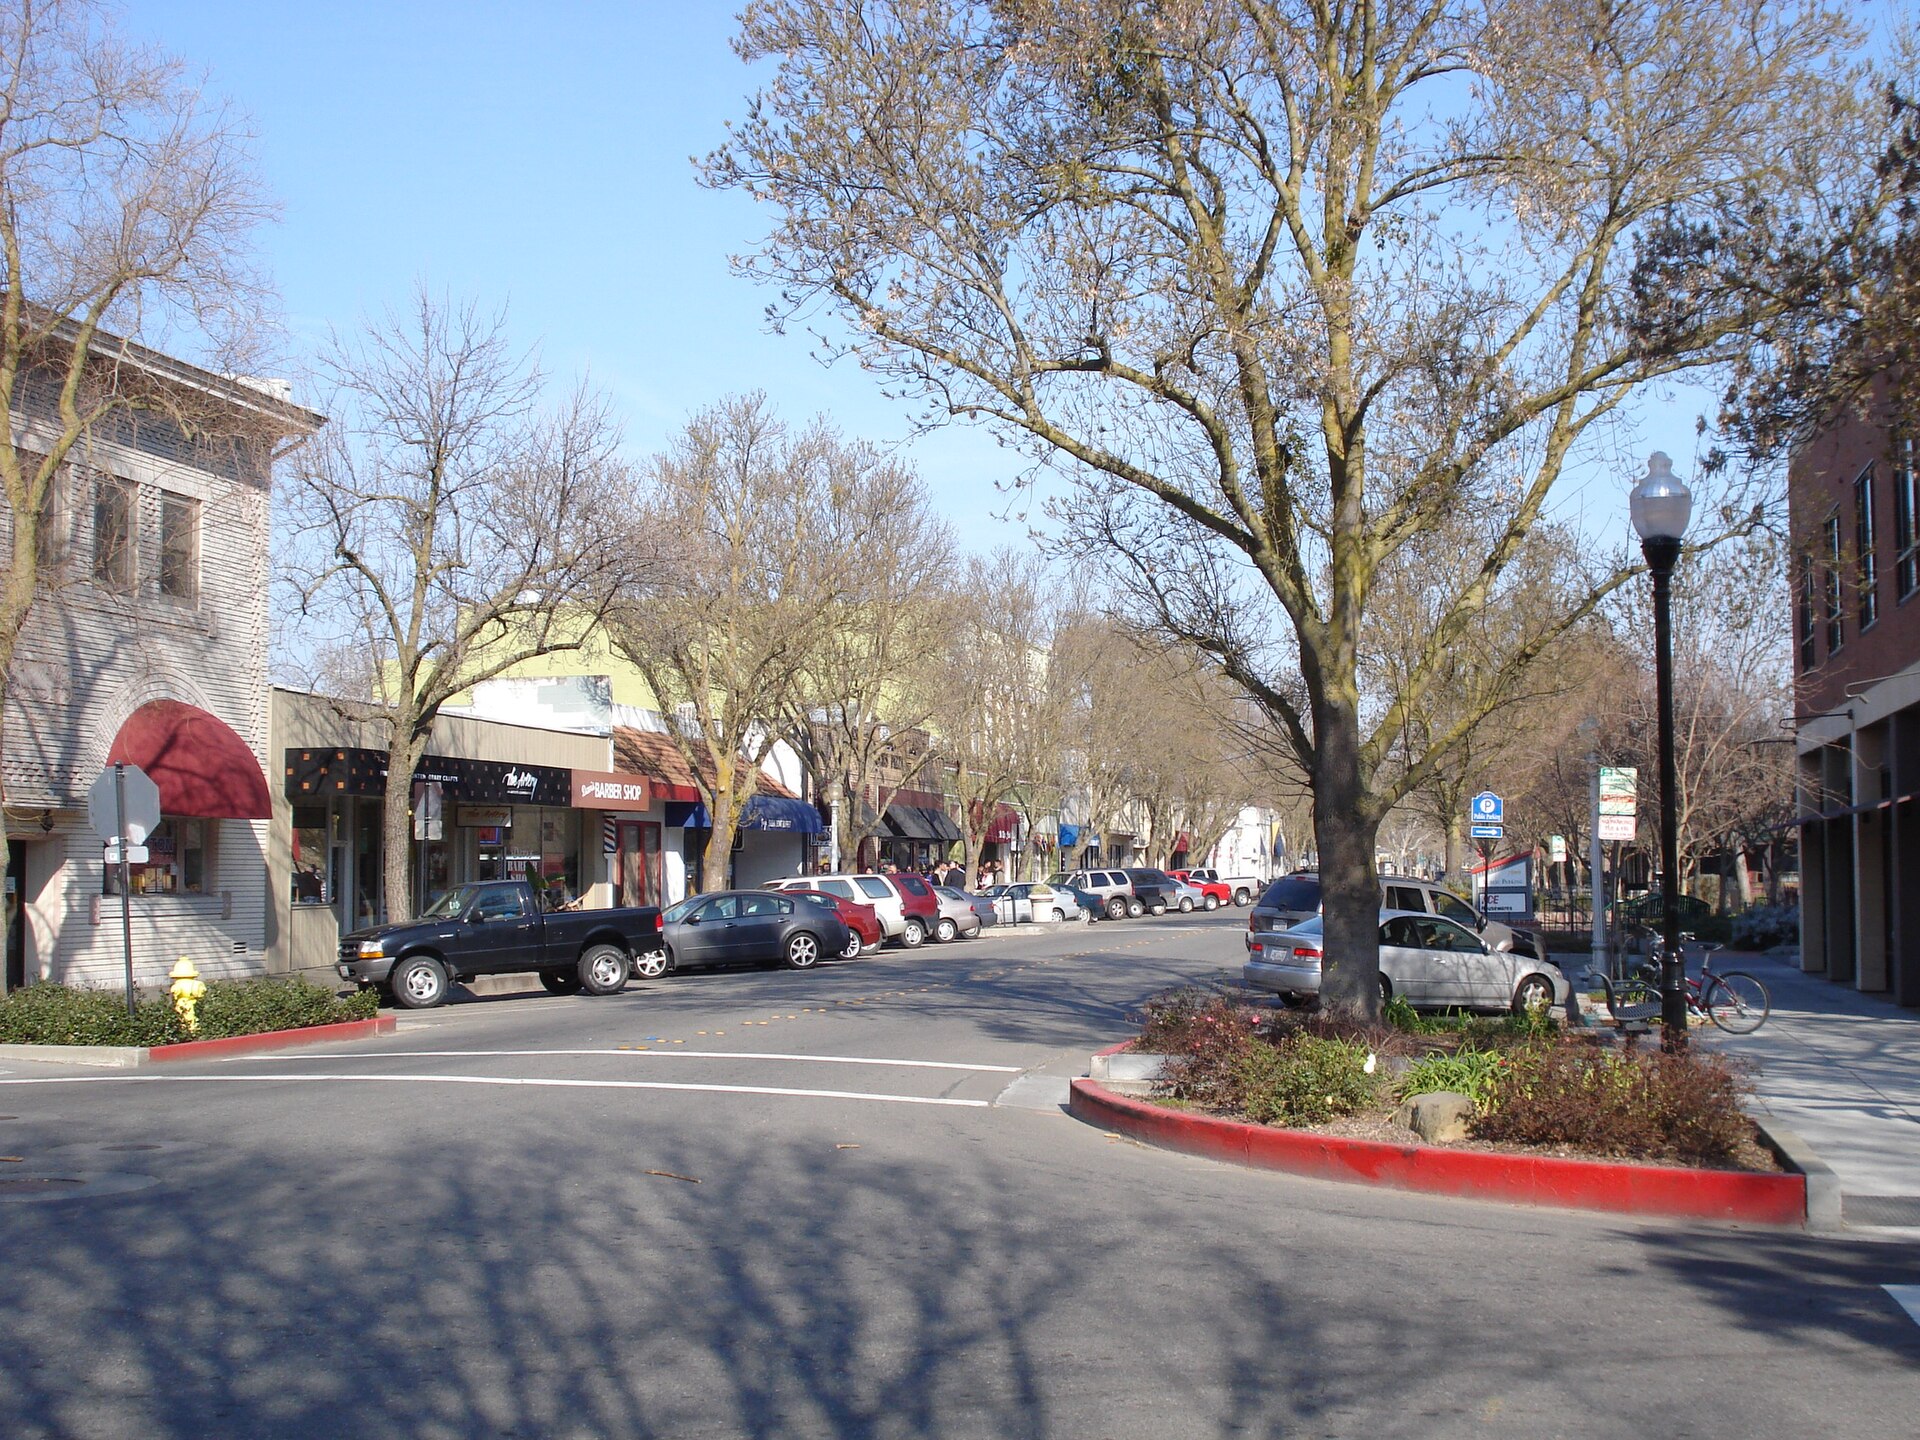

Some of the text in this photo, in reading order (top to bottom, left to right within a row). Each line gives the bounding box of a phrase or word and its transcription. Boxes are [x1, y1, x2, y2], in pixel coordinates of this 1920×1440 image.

[595, 782, 622, 799] BARBER
[624, 784, 641, 800] SHOP
[1486, 813, 1500, 821] Parking
